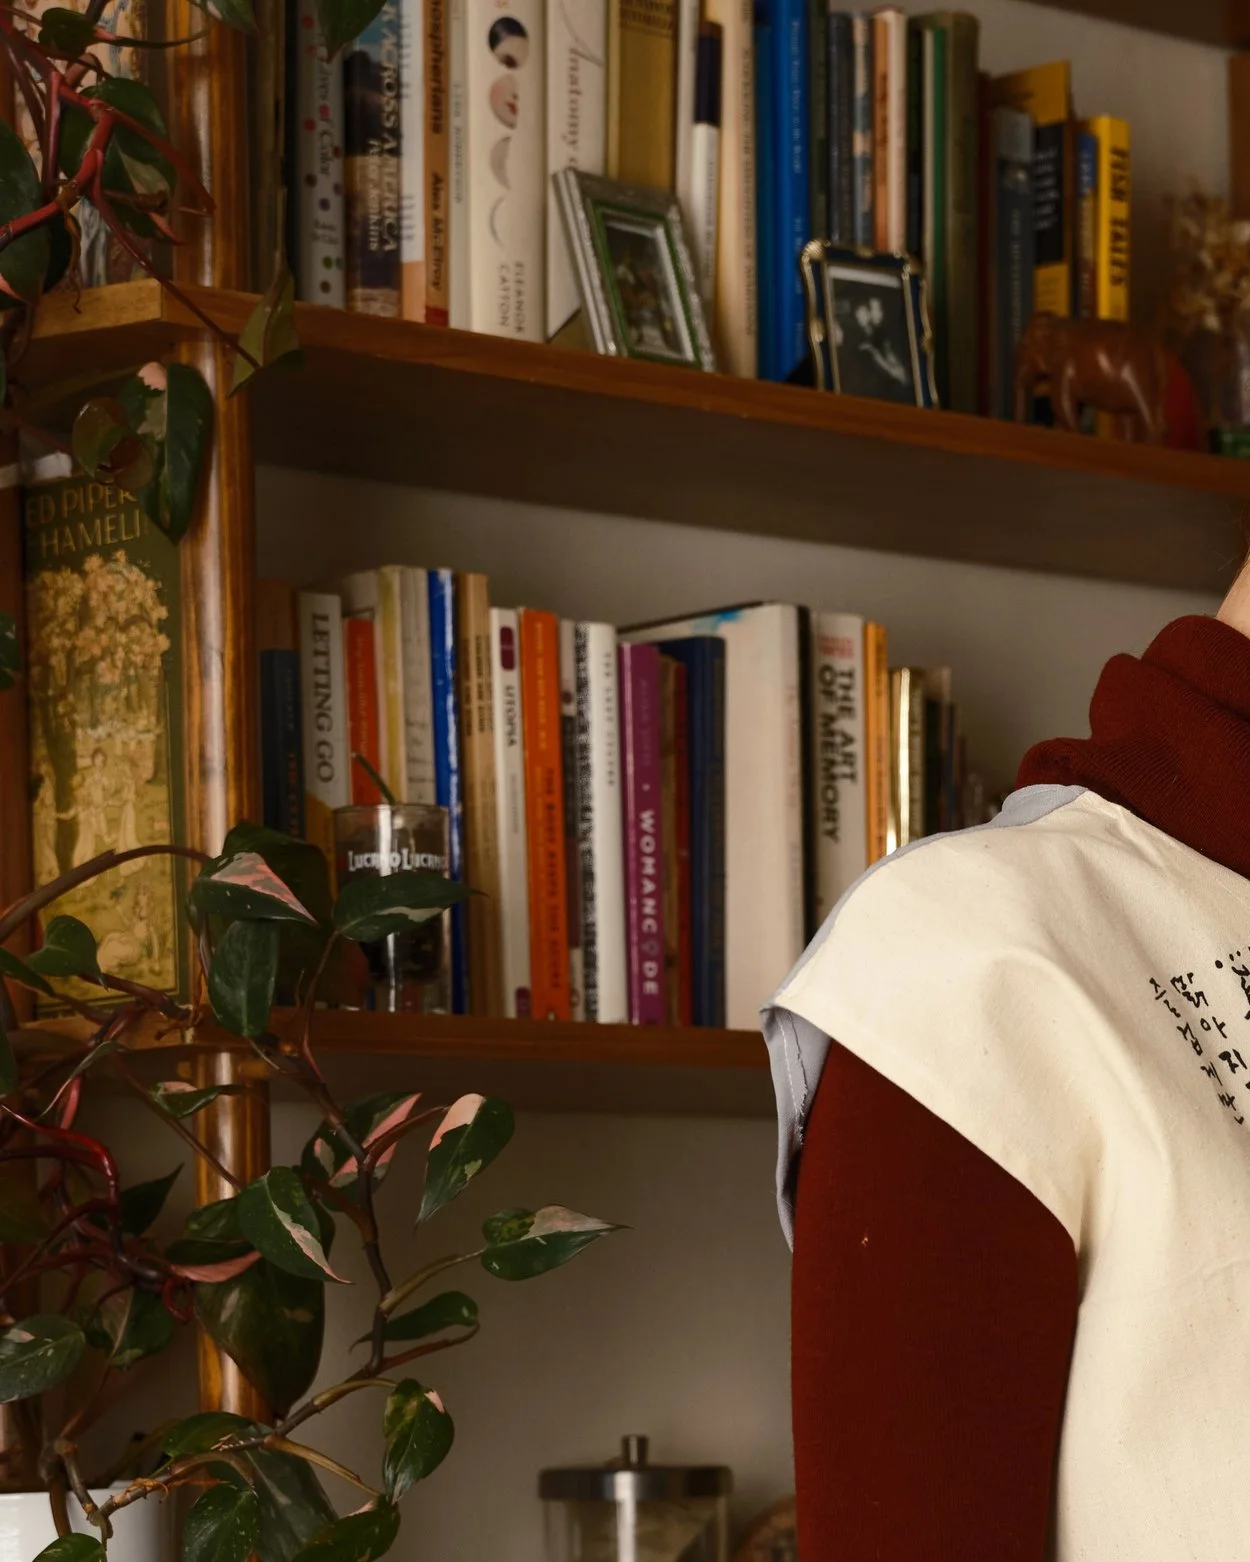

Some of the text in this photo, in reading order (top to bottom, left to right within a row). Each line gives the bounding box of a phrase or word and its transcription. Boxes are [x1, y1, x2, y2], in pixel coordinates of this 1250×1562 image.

[379, 27, 399, 129] ACROSS
[318, 130, 335, 178] Color
[1110, 146, 1129, 203] FISH
[366, 183, 382, 252] Jenkins
[381, 133, 400, 252] AMERICA
[431, 171, 445, 211] Alex
[498, 263, 512, 328] CATTON
[513, 260, 526, 335] ELEANOR
[61, 482, 140, 518] PIPER
[41, 508, 148, 559] HAMELI
[310, 613, 336, 783] LETTING GO
[504, 684, 519, 748] UTOPIA
[818, 664, 836, 703] OF
[837, 666, 858, 785] THE ART
[819, 714, 840, 844] MEMORY
